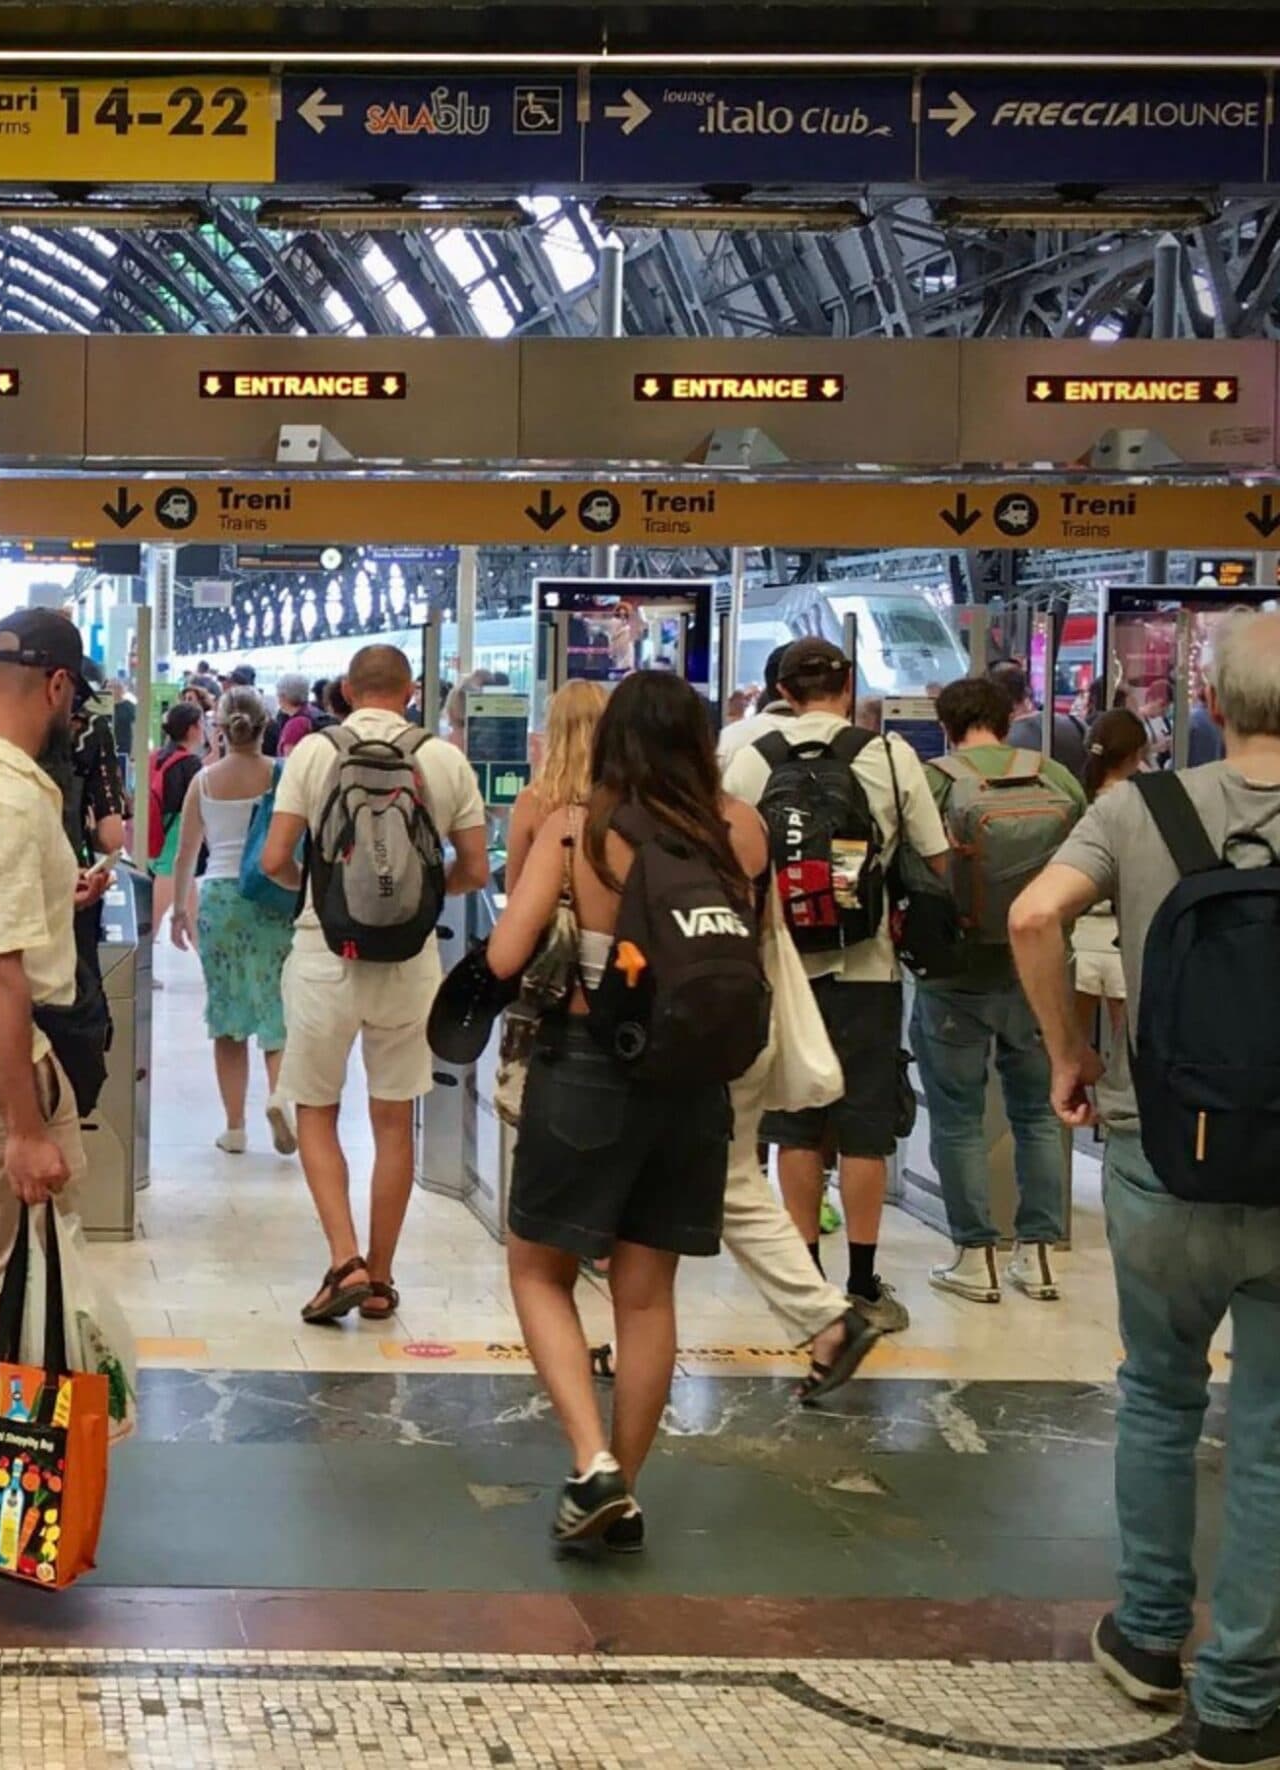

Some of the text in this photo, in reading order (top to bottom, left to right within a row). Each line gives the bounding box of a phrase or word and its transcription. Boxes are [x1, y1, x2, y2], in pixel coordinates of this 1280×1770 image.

[663, 89, 715, 106] lounge
[60, 87, 248, 135] 14-22
[800, 106, 869, 134] Club
[235, 377, 368, 396] ENTRANCE
[673, 379, 807, 398] ENTRANCE
[1065, 382, 1200, 400] ENTRANCE
[217, 486, 291, 510] Treni
[641, 489, 715, 513] Treni
[1060, 492, 1136, 515] Treni
[219, 515, 267, 531] Trains
[642, 517, 691, 534] Trains
[1061, 519, 1110, 538] Trains
[671, 906, 749, 938] VANS
